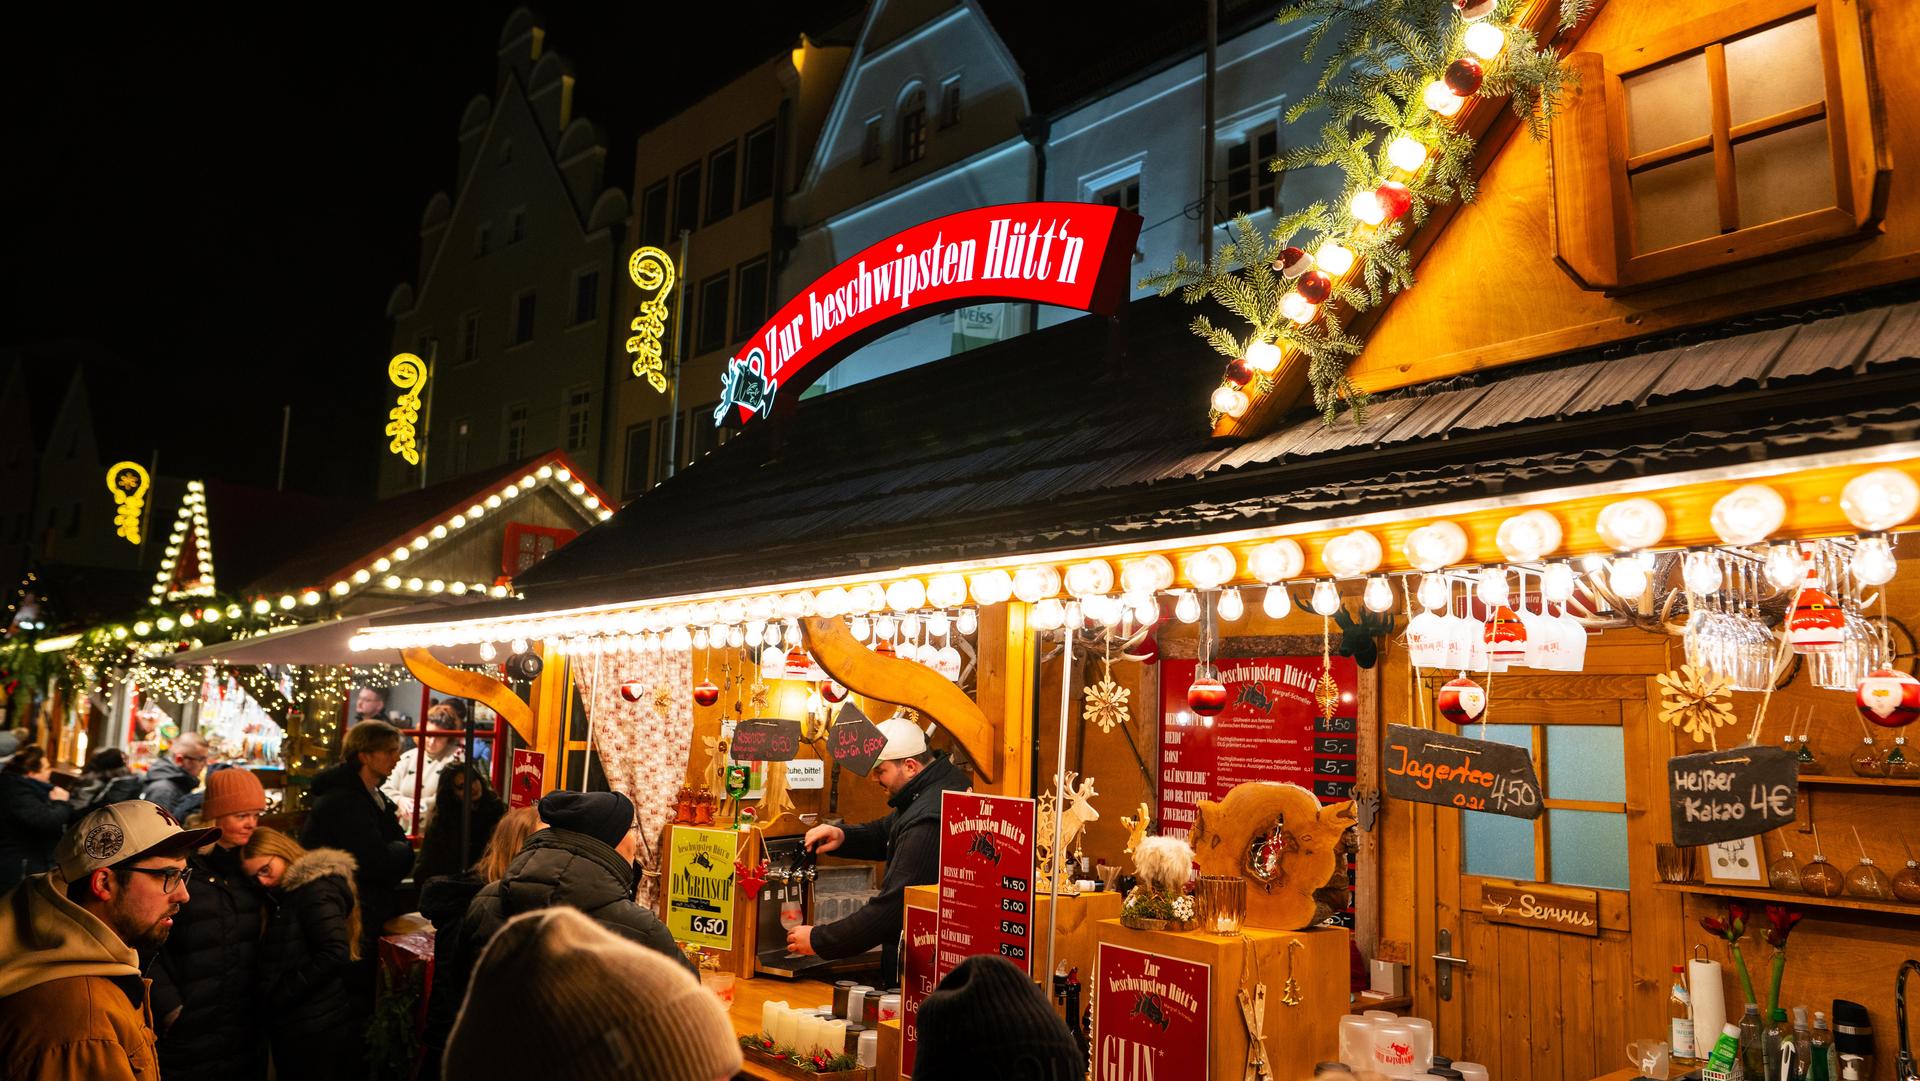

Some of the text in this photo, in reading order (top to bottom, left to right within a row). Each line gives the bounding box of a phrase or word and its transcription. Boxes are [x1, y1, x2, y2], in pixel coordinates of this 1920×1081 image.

[764, 313, 804, 376] Zur
[808, 231, 977, 343] beschwipsten
[1387, 745, 1536, 811] Jagertee 4,50
[1674, 769, 1736, 792] Heißer
[980, 799, 994, 816] Zur
[1684, 784, 1794, 822] Kakao 4€
[949, 816, 999, 835] beschwipsten
[1519, 894, 1594, 926] Servus
[693, 916, 724, 936] 6,50
[1144, 958, 1160, 977] Zur
[1109, 974, 1167, 997] beschwipsten
